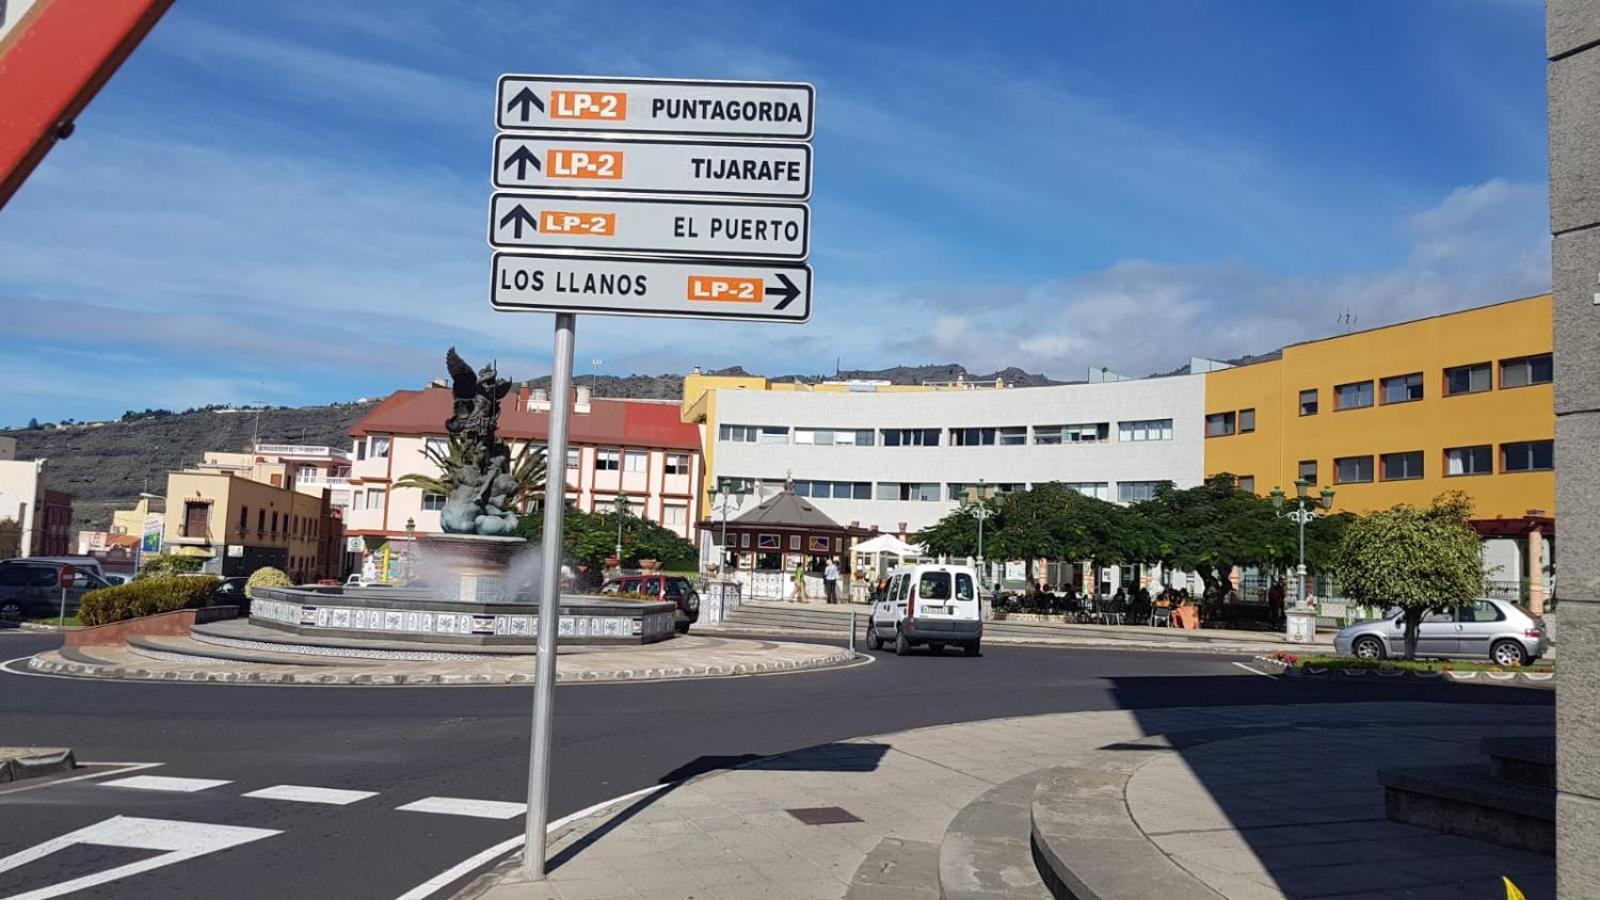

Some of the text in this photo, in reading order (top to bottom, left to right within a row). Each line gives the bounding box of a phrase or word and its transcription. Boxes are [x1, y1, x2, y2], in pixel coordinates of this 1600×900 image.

[558, 93, 803, 123] LP-2 PUNTAGORDA
[555, 151, 801, 182] LP-2 TIJARAFE
[546, 215, 799, 242] LP-2 EL PUERTO
[501, 268, 754, 299] LOS LLANOS LP-2
